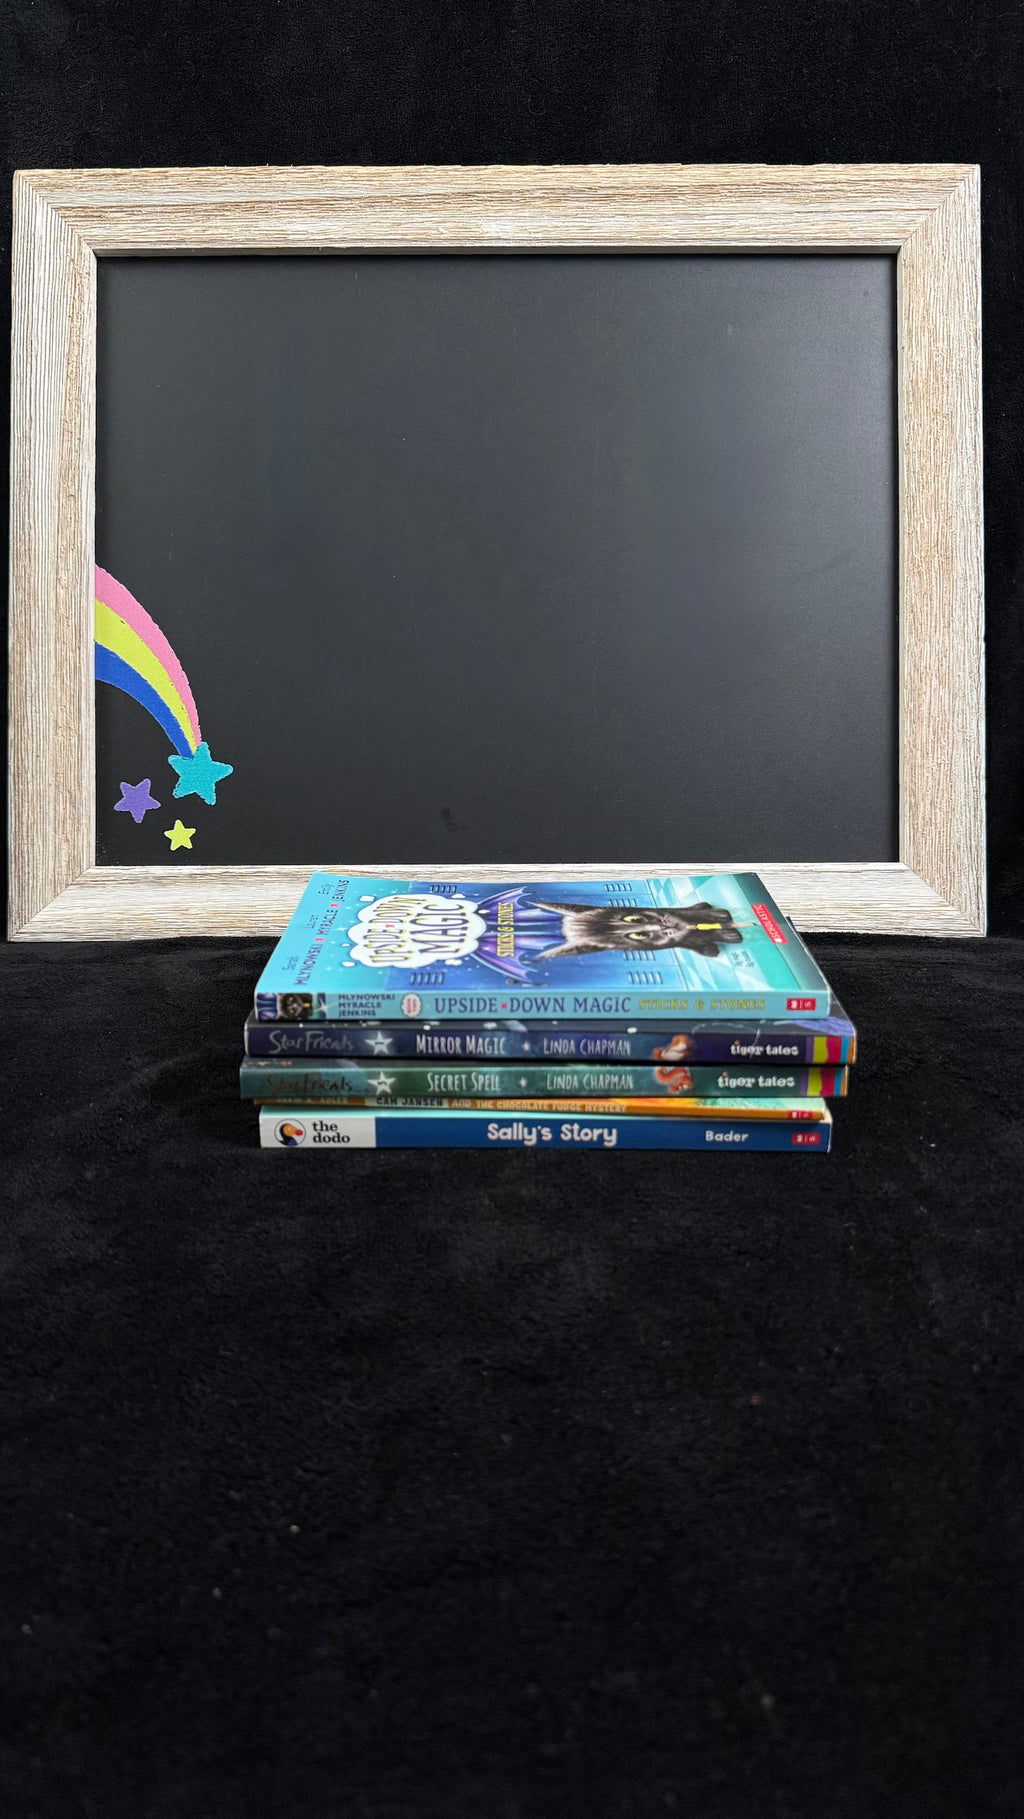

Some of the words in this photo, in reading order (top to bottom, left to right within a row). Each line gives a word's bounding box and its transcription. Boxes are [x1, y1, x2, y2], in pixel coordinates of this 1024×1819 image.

[368, 896, 428, 923] DOWN
[409, 904, 470, 954] MAGIC
[363, 928, 416, 963] UPSIDE
[338, 993, 396, 1001] MLYNOWSKI
[338, 1001, 382, 1009] MYRACLE
[434, 996, 498, 1014] UPSIDE
[509, 997, 566, 1014] DOWN
[572, 996, 631, 1014] MAGIC
[638, 998, 688, 1011] STICKS
[709, 998, 766, 1011] STONES
[338, 1009, 377, 1017] JENKINS
[416, 1034, 461, 1055] MIRROR
[466, 1034, 506, 1055] MAGIC
[543, 1037, 576, 1055] LINDA
[579, 1037, 632, 1056] CHAPMAN
[730, 1040, 764, 1056] tiger
[765, 1044, 799, 1056] tales
[427, 1072, 467, 1092] SECRET
[471, 1072, 500, 1092] SPELL
[546, 1073, 578, 1091] LINDA
[582, 1073, 634, 1091] CHAPMAN
[717, 1071, 755, 1088] tiger
[757, 1075, 795, 1088] tales
[402, 1096, 443, 1107] JANSEN
[476, 1100, 494, 1109] THE
[497, 1101, 548, 1110] CHOCOLATE
[552, 1102, 582, 1112] FUDGE
[585, 1103, 627, 1113] MYSTERY
[312, 1120, 338, 1132] the
[487, 1122, 552, 1146] Sally's
[560, 1122, 618, 1147] Story
[312, 1132, 350, 1144] dodo
[705, 1130, 749, 1142] Bader
